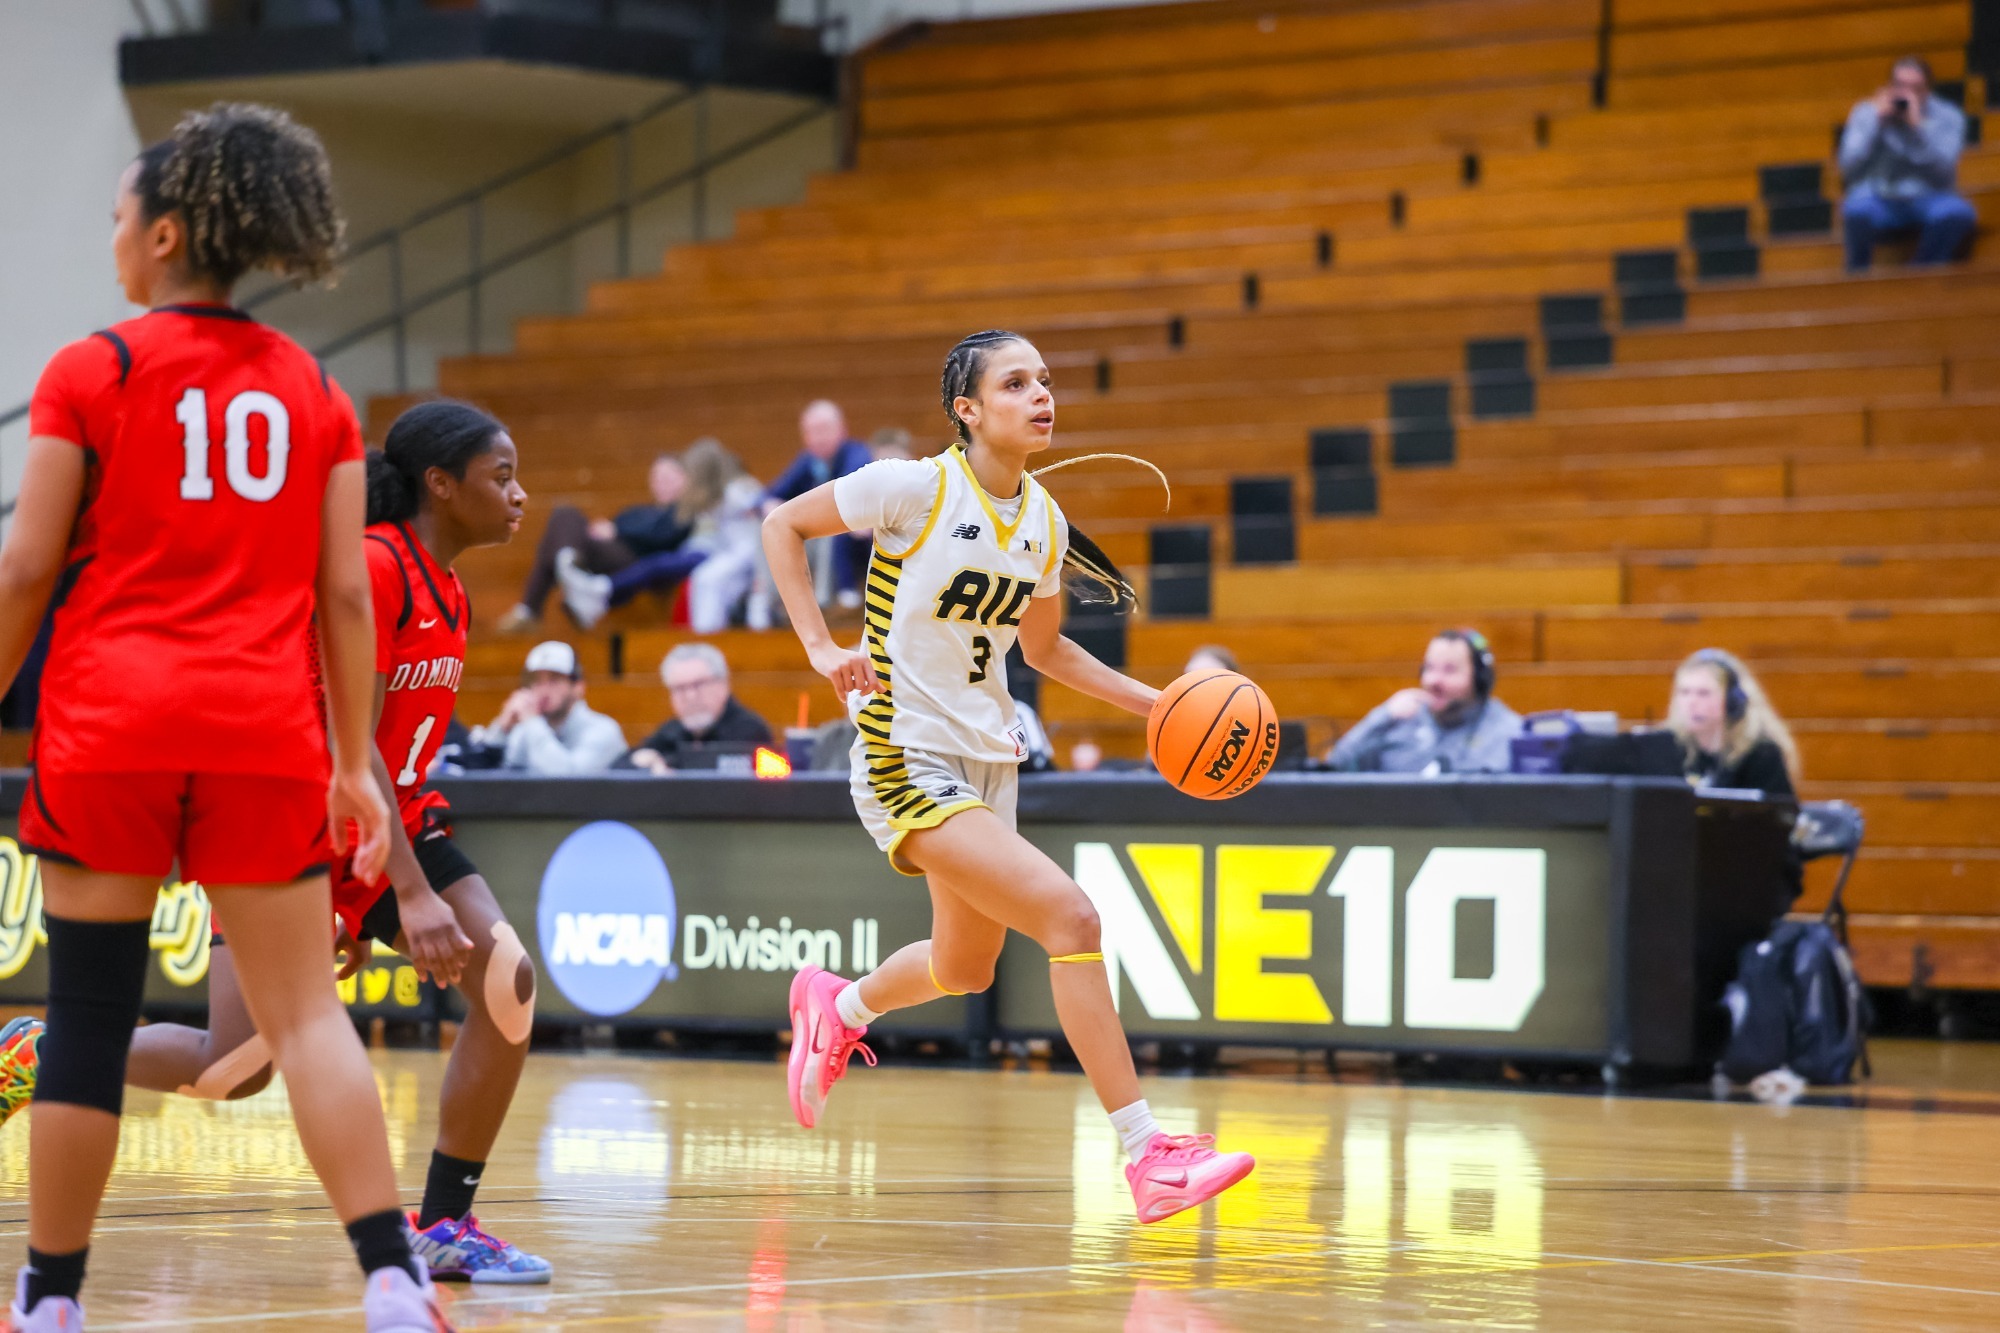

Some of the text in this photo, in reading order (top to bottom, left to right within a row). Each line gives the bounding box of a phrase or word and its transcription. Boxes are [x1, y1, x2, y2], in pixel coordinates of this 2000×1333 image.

[175, 387, 292, 502] 10
[934, 567, 1038, 628] AIC
[968, 635, 991, 685] 3
[396, 715, 437, 787] 1
[1204, 719, 1251, 782] NCAA
[1225, 721, 1277, 796] Wilson
[551, 911, 671, 967] NCAA
[683, 914, 879, 973] Division II
[1074, 842, 1547, 1031] NE10
